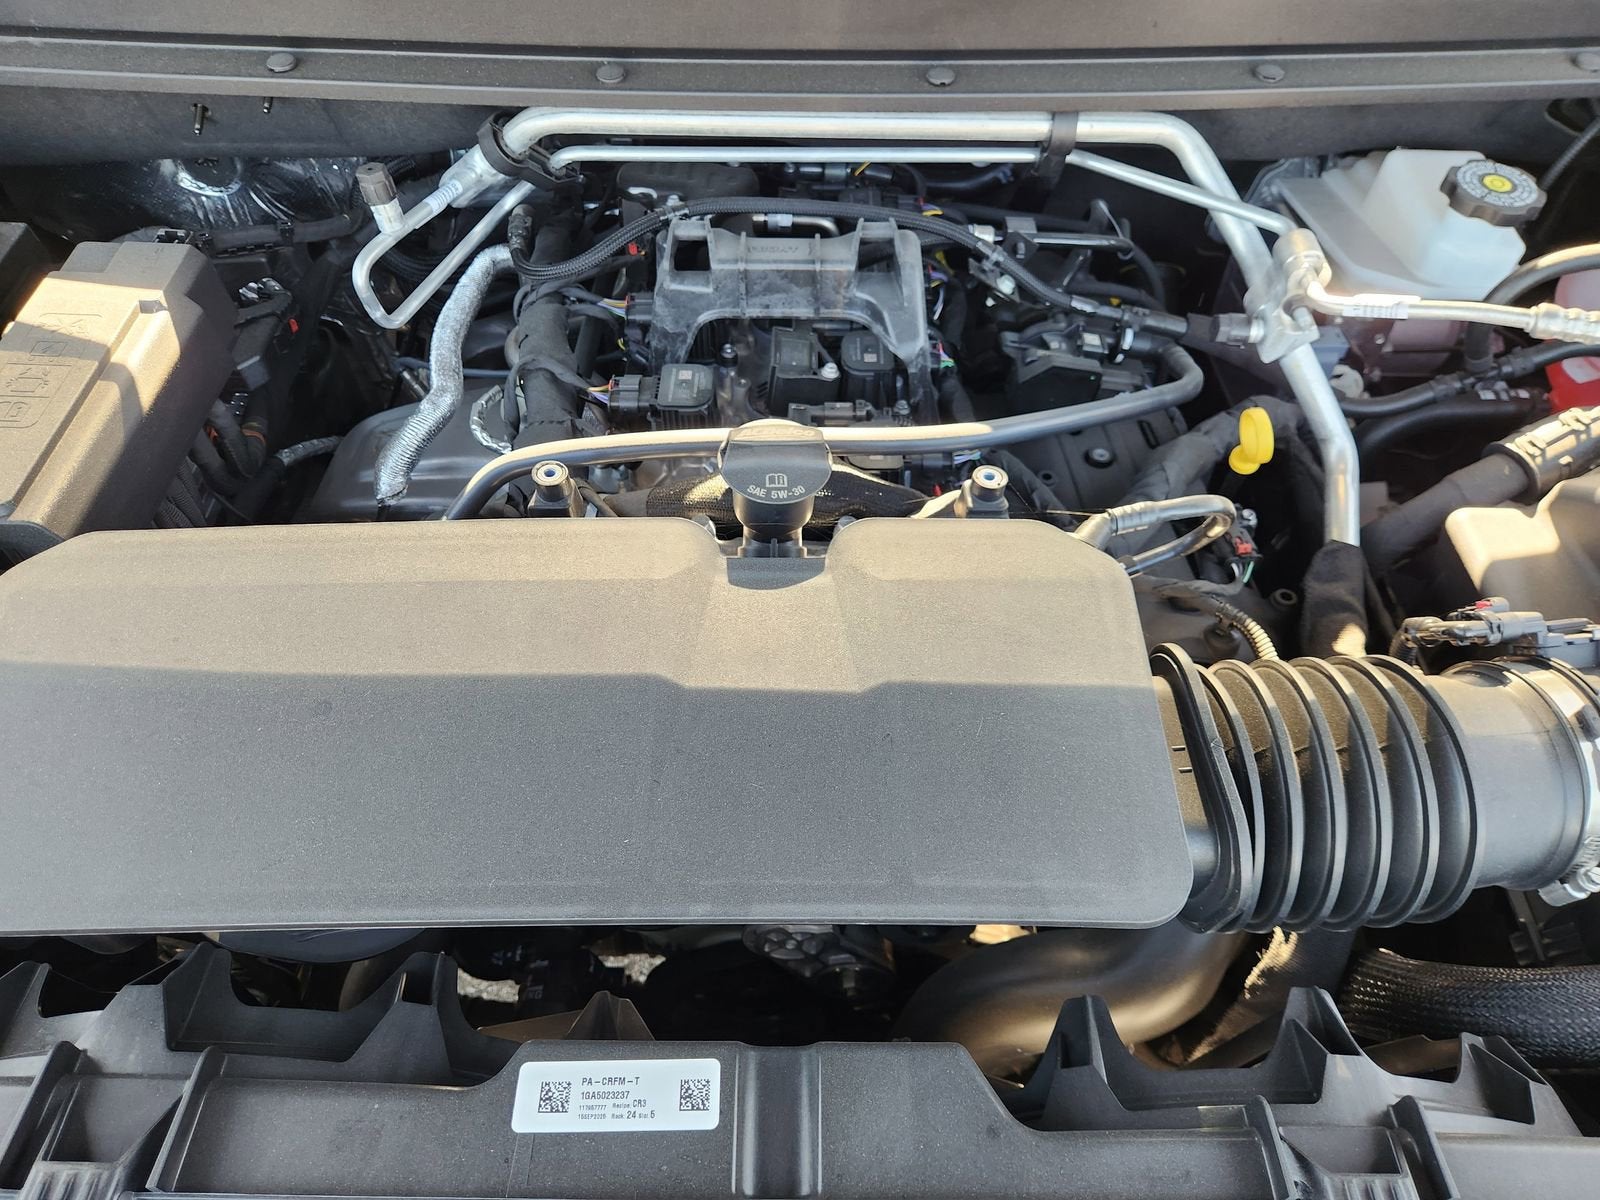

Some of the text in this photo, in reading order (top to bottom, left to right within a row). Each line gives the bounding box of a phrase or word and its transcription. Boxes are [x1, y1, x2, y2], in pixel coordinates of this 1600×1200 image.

[746, 484, 806, 499] SAE 5W-30
[632, 1099, 647, 1108] CR3
[626, 1110, 637, 1119] 24
